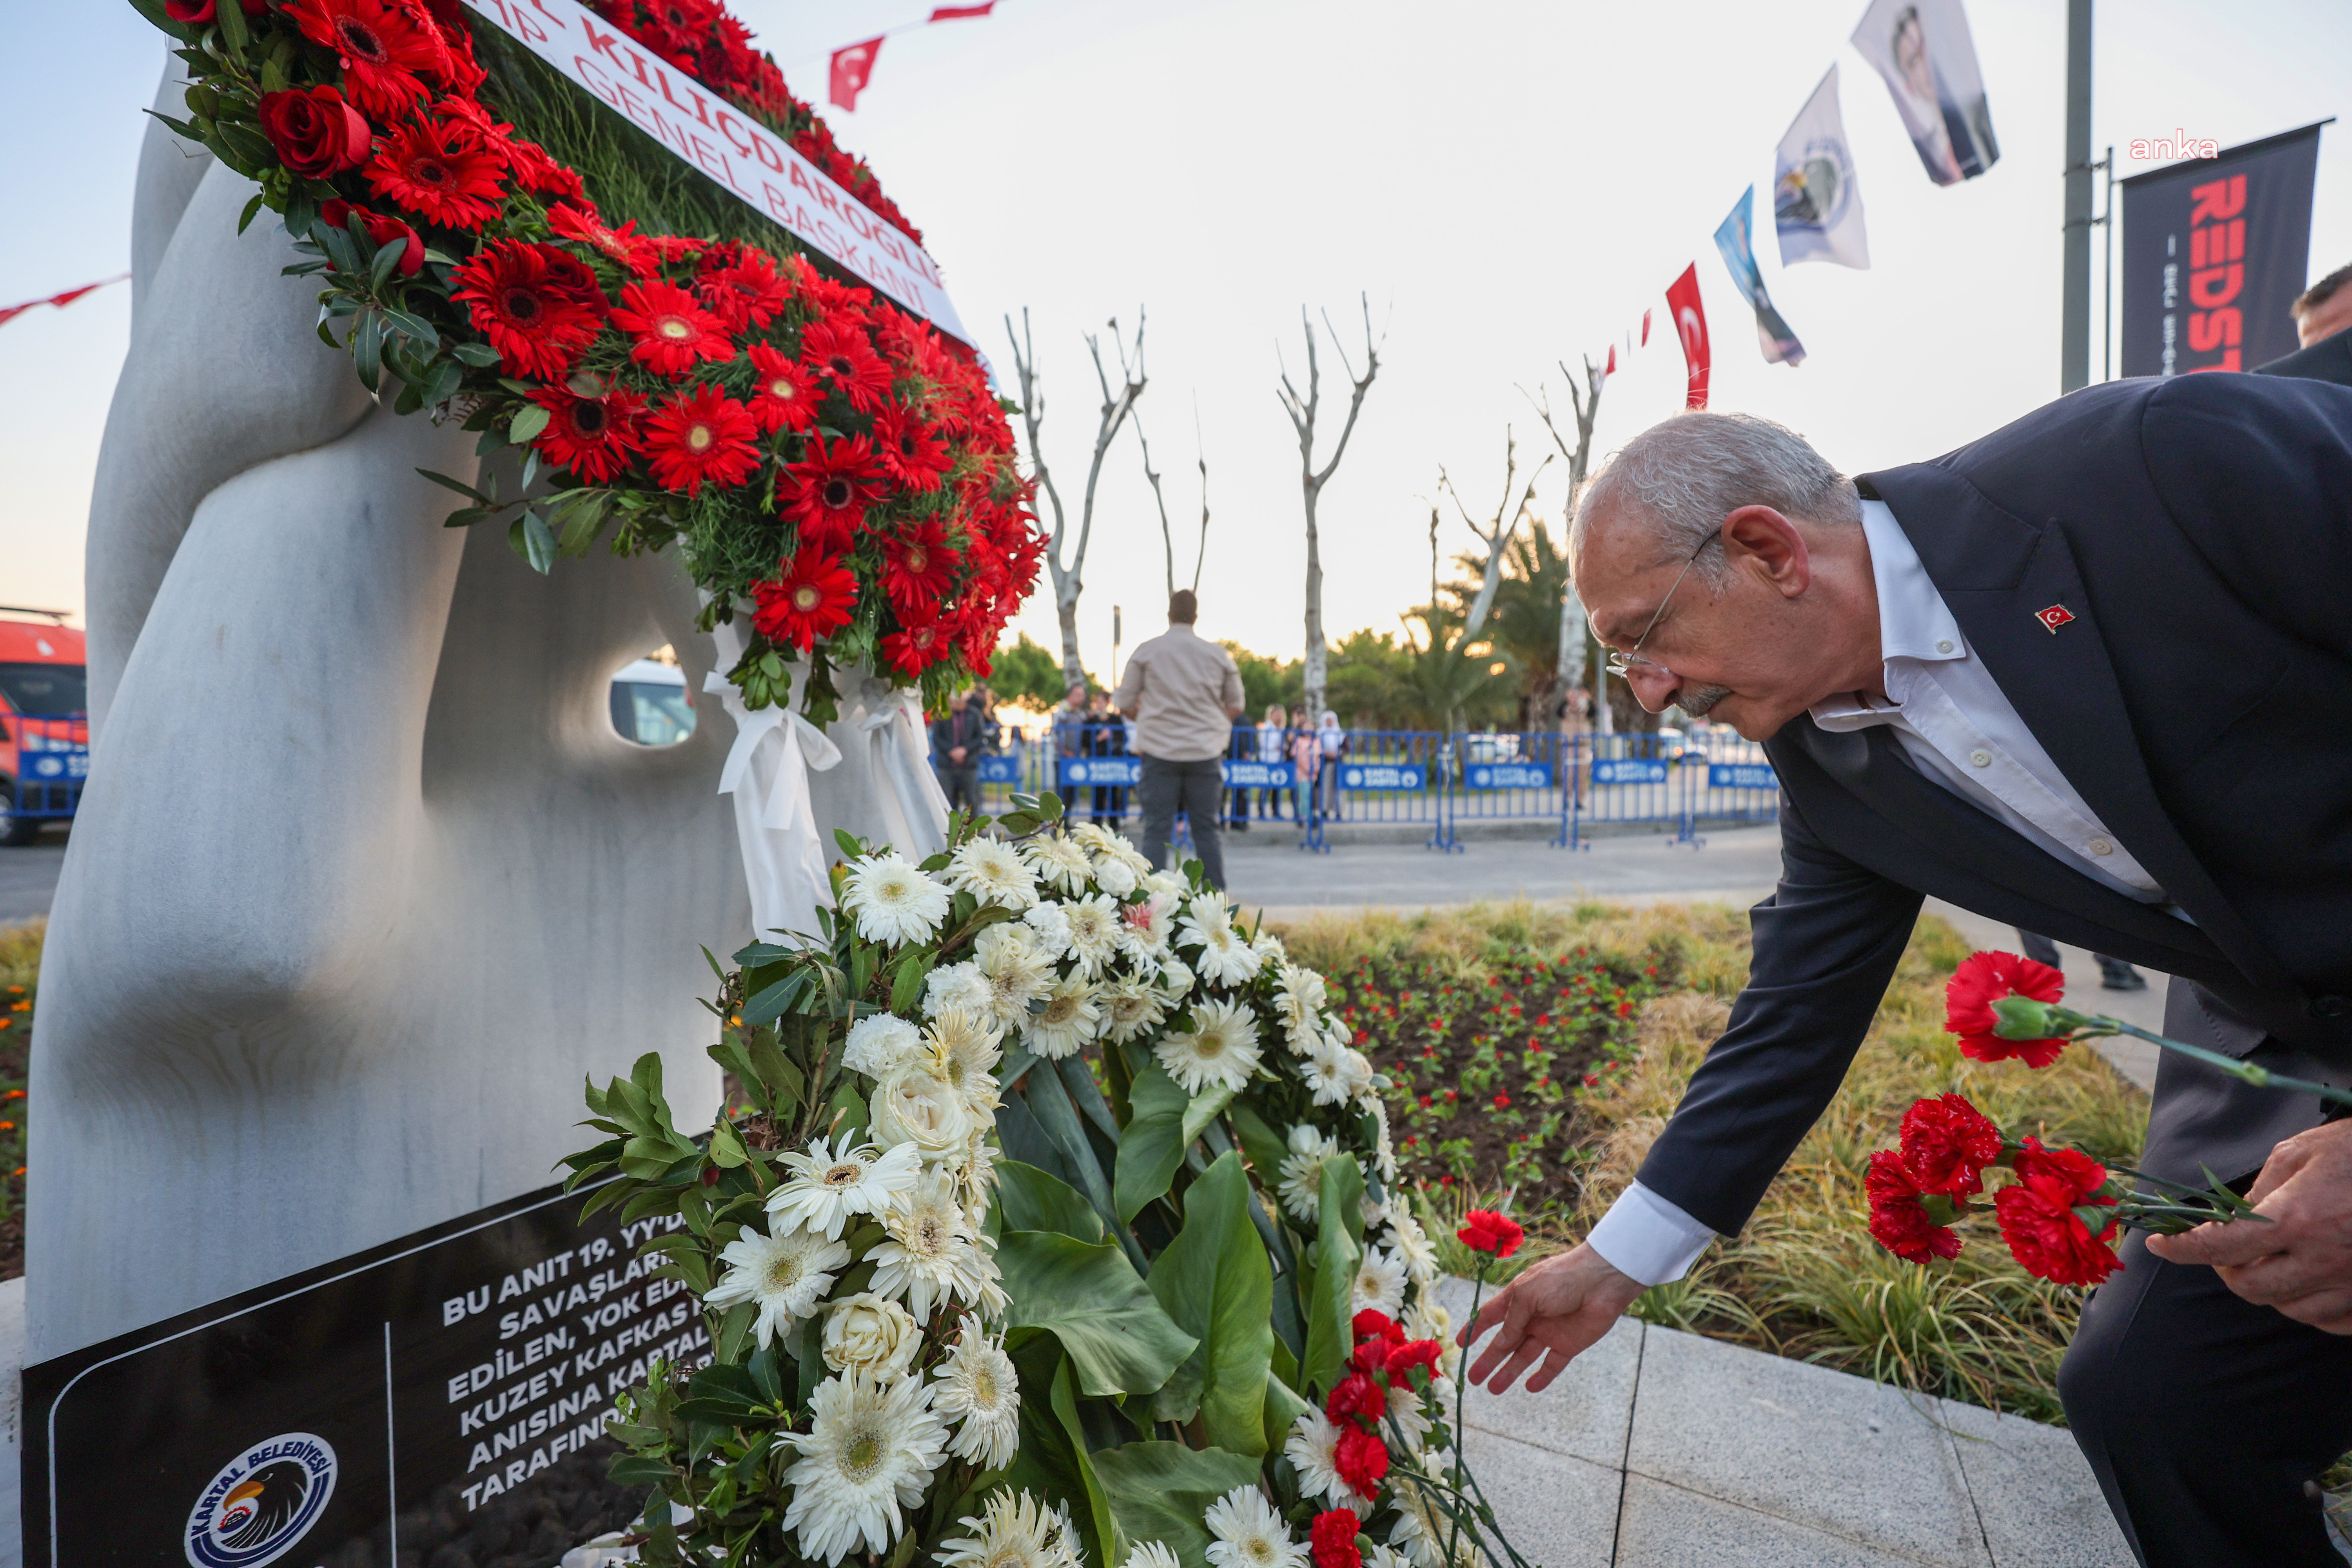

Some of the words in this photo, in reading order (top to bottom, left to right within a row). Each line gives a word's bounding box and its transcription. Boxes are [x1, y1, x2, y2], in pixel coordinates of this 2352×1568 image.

[574, 55, 754, 201] GENEL
[579, 14, 944, 290] KILIÇDAROĞLU
[443, 1285, 490, 1327] BU
[497, 1250, 574, 1304] ANIT
[578, 1237, 616, 1267] 19.
[619, 1211, 688, 1249] YY'D
[499, 1249, 674, 1340] SAVAŞLARI
[448, 1325, 577, 1404] EDİLEN,
[581, 1290, 642, 1336] YOK
[460, 1360, 570, 1437] KUZEY
[576, 1302, 689, 1377] KAFKAS
[467, 1382, 603, 1474] ANISINA
[191, 1467, 246, 1536] KARTAL
[248, 1440, 332, 1475] BELEDİYESİ
